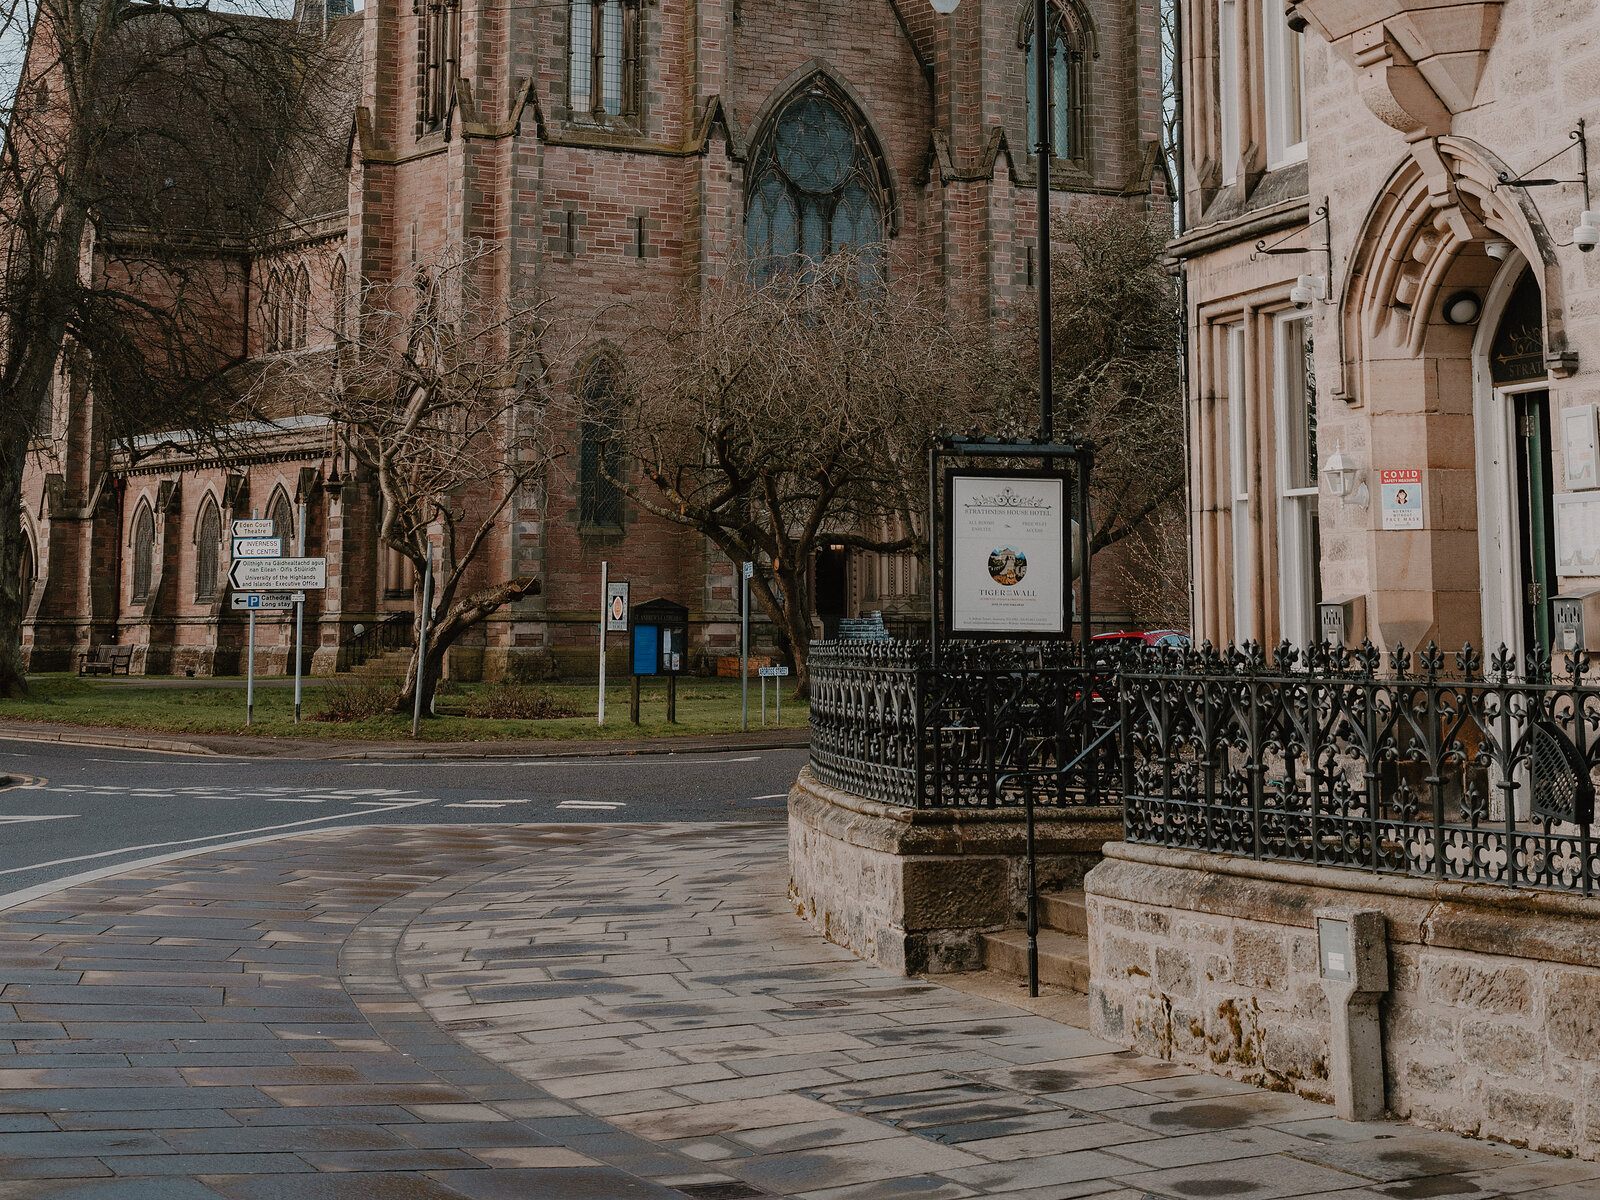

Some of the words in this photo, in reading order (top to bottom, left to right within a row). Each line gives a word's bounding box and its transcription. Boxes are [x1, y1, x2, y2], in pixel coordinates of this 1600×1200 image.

[1029, 509, 1052, 517] HOTEL
[979, 589, 1006, 597] TIGER
[251, 596, 258, 607] P
